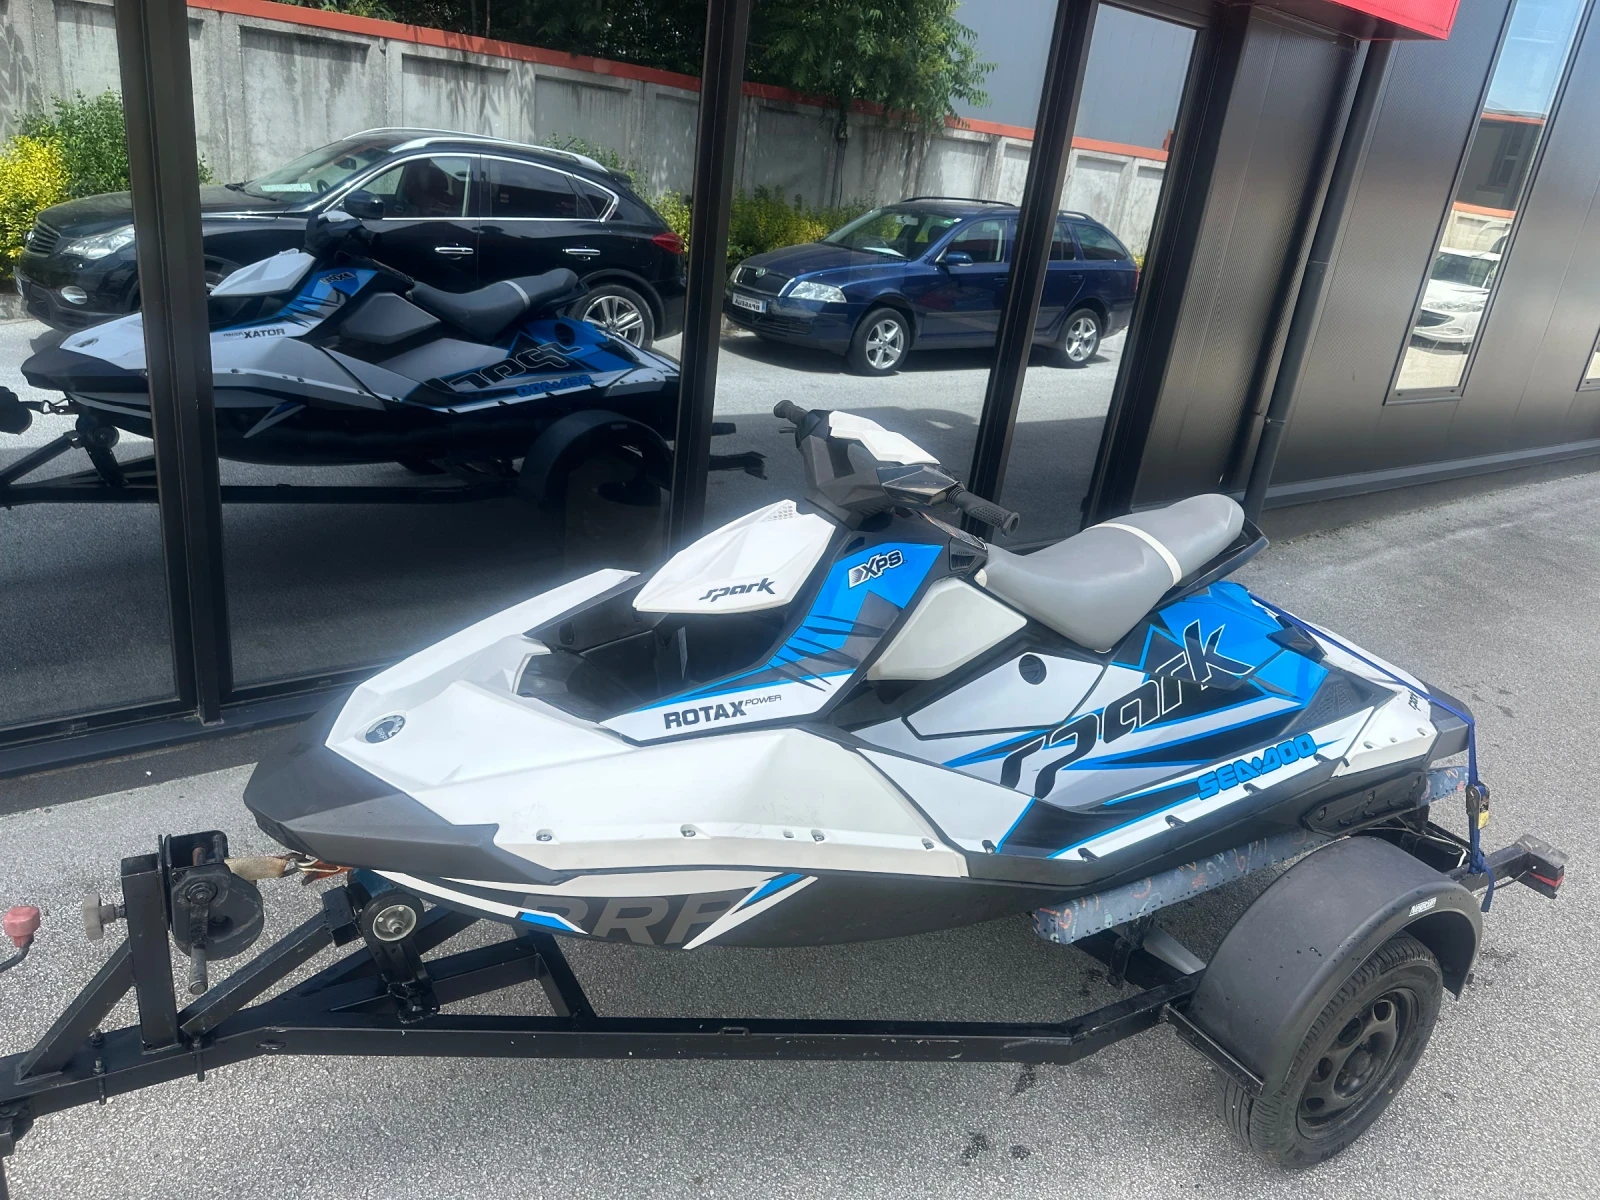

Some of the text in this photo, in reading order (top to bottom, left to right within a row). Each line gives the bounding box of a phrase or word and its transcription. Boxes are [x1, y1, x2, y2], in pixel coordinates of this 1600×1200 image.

[861, 550, 903, 580] XPS
[699, 577, 776, 602] spark
[663, 694, 782, 729] ROTAX POWER
